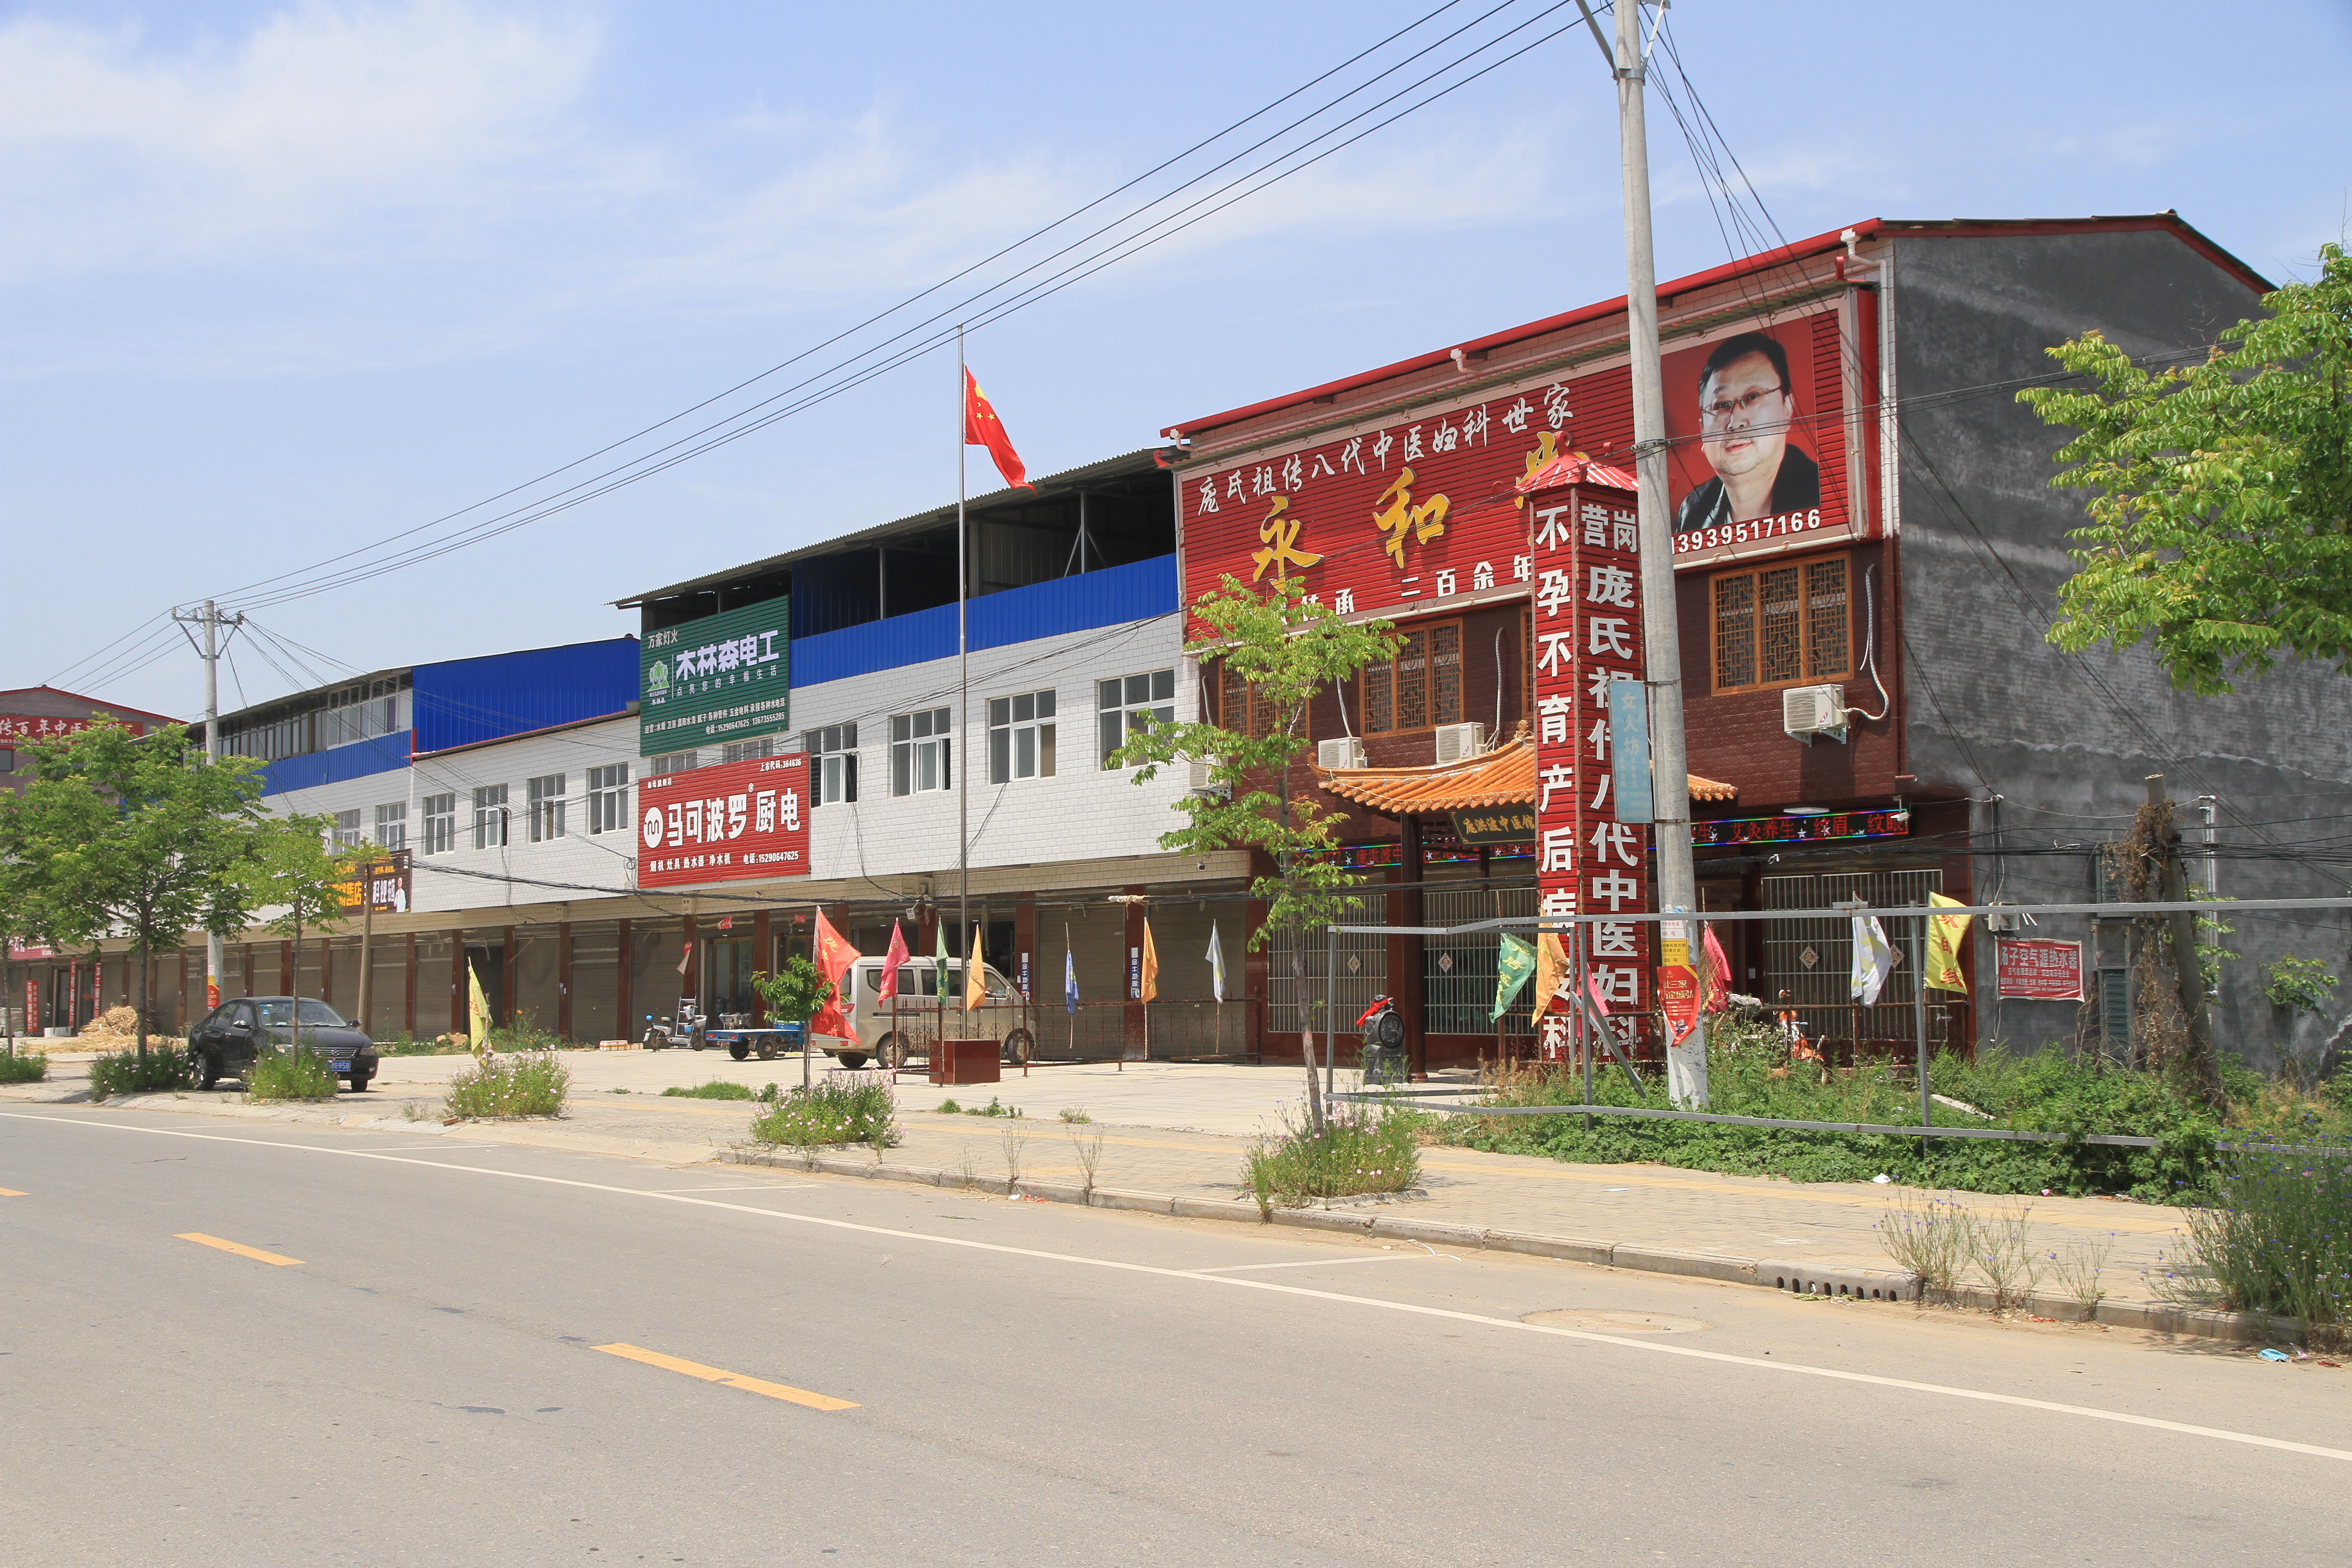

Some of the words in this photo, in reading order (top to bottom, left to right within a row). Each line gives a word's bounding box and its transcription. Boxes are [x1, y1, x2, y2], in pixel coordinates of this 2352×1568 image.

[1198, 382, 1574, 516] 庞氏祖传八代中医妇科世家
[1581, 503, 1637, 553] 营岗
[1671, 509, 1821, 555] 13939517166
[1401, 554, 1532, 598] 二百余年
[648, 629, 678, 649] 万家灯火
[676, 630, 779, 681] 木林森电工
[676, 665, 777, 696] 点亮您的幸福生活
[651, 697, 666, 706] 木林森
[667, 720, 676, 729] 卫浴
[677, 715, 696, 727] 晨阳水漆
[697, 713, 707, 723] 腻子
[708, 709, 728, 722] 各种管件
[730, 705, 749, 717] 五金电料
[750, 697, 785, 713] 承接各种水电活
[752, 712, 784, 725] 13673555285
[1621, 691, 1639, 756] 女人坊
[760, 758, 801, 772] 上市代码:364636
[666, 794, 747, 847] 马可波罗
[755, 788, 800, 833] 厨电
[1464, 815, 1535, 834] 庞洪波中医馆
[650, 860, 664, 872] 烟机
[666, 858, 680, 870] 灶具
[683, 855, 704, 869] 热水器
[709, 853, 730, 866] 净水机
